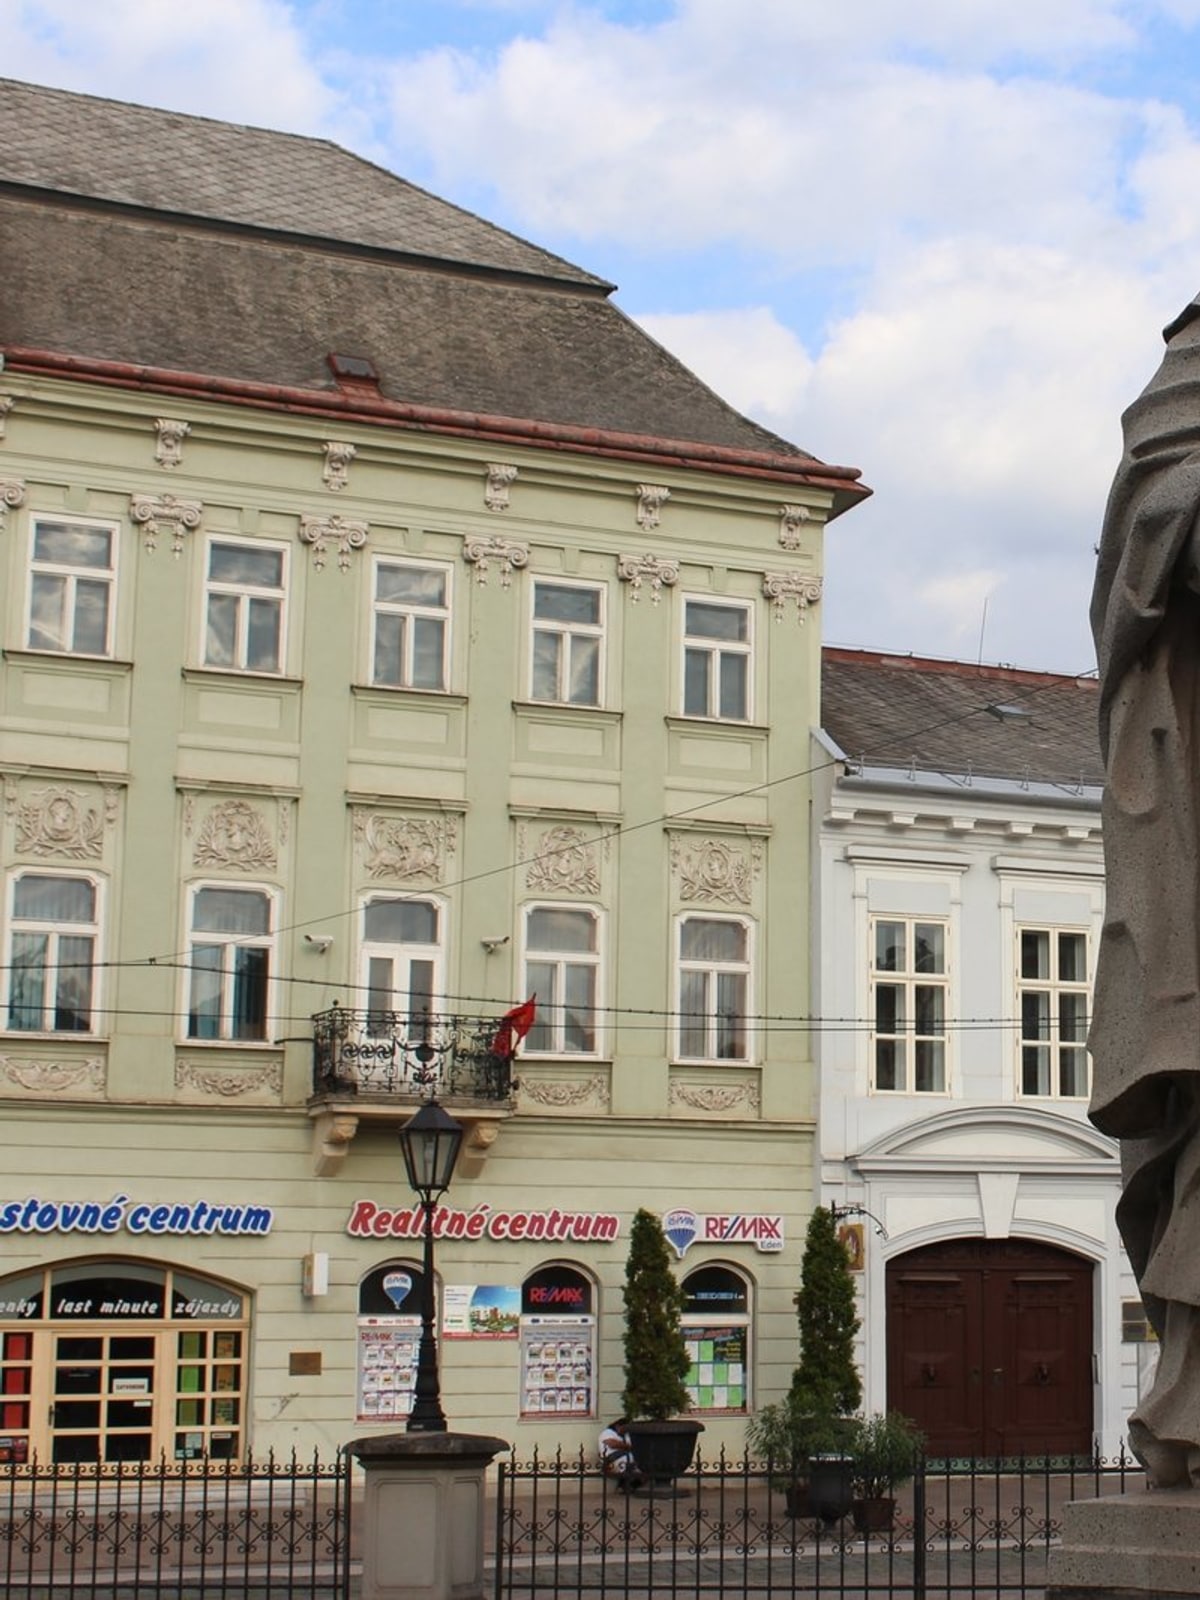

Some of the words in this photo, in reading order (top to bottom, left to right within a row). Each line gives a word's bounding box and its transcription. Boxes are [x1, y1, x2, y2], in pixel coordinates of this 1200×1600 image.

[0, 1196, 128, 1230] stovné
[130, 1202, 272, 1232] centrum
[350, 1201, 489, 1237] Realtné
[490, 1210, 618, 1239] centrum
[705, 1216, 782, 1240] RE/MAX
[760, 1241, 783, 1249] Eden
[530, 1286, 583, 1303] RE/MAX
[56, 1298, 92, 1314] last
[100, 1299, 159, 1314] minute
[174, 1298, 241, 1318] zájazdy
